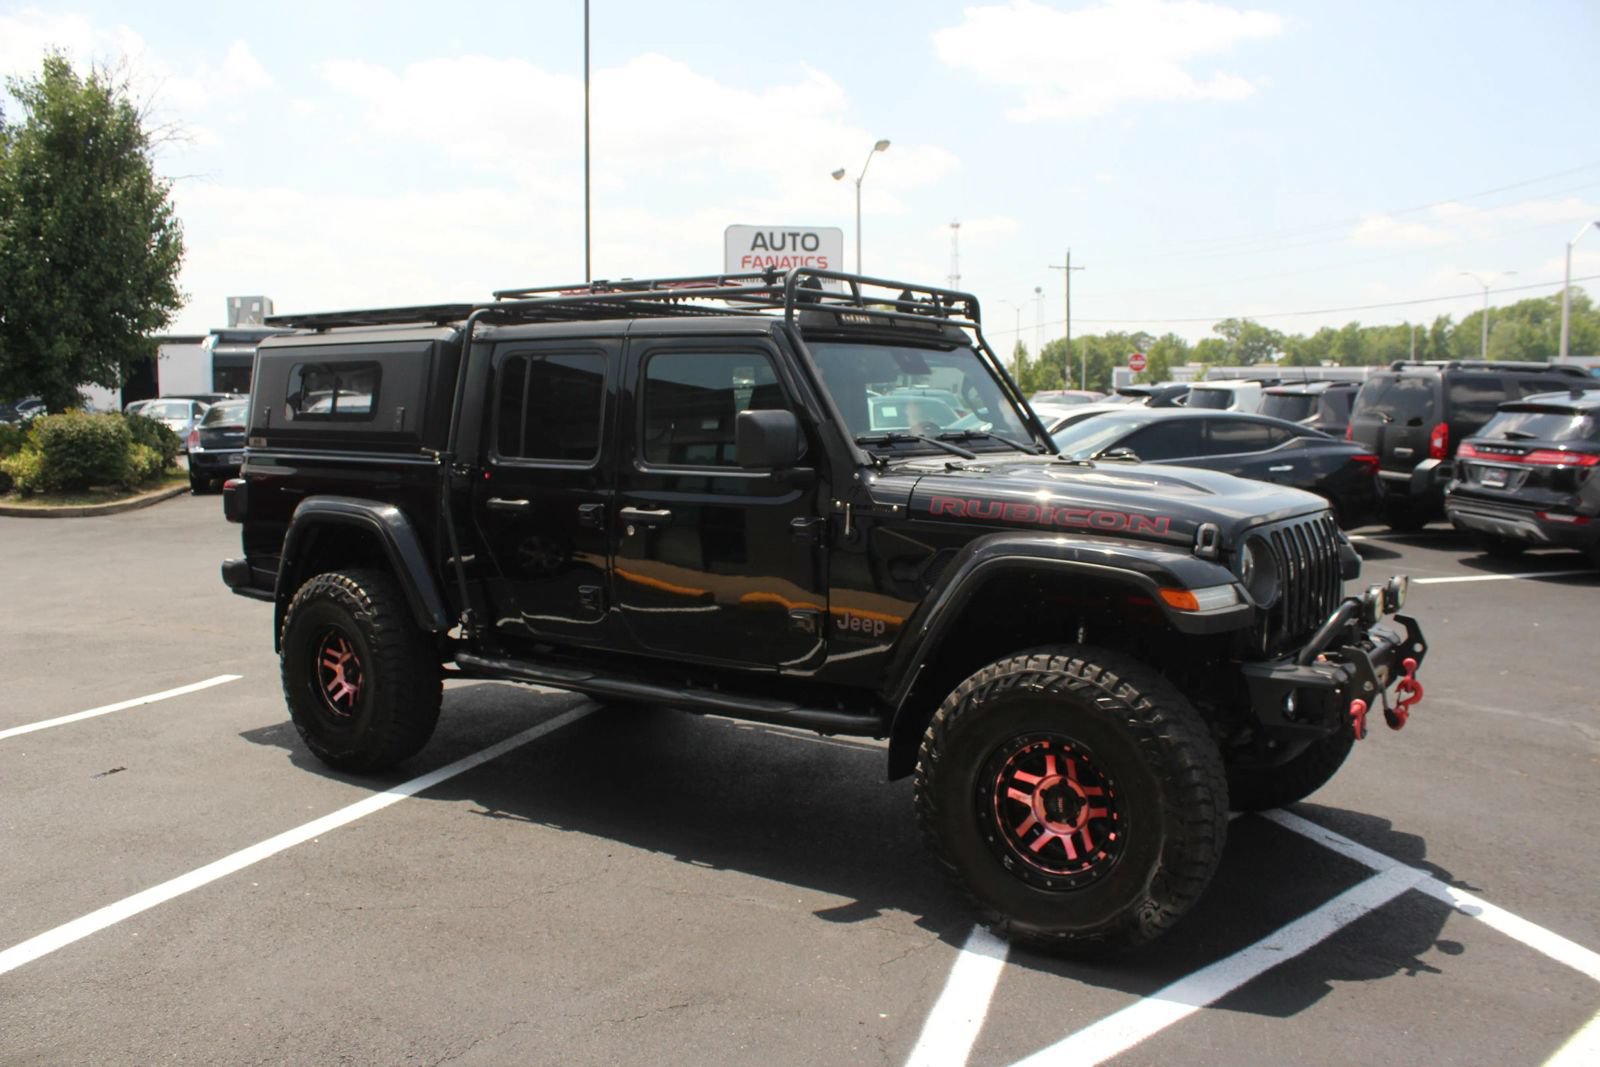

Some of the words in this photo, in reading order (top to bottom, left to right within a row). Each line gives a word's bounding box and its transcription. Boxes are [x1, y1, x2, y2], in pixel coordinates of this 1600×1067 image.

[751, 231, 820, 252] AUTO
[741, 255, 829, 270] FANATICS
[929, 495, 1171, 536] RUBICON
[836, 612, 886, 637] Jeep
